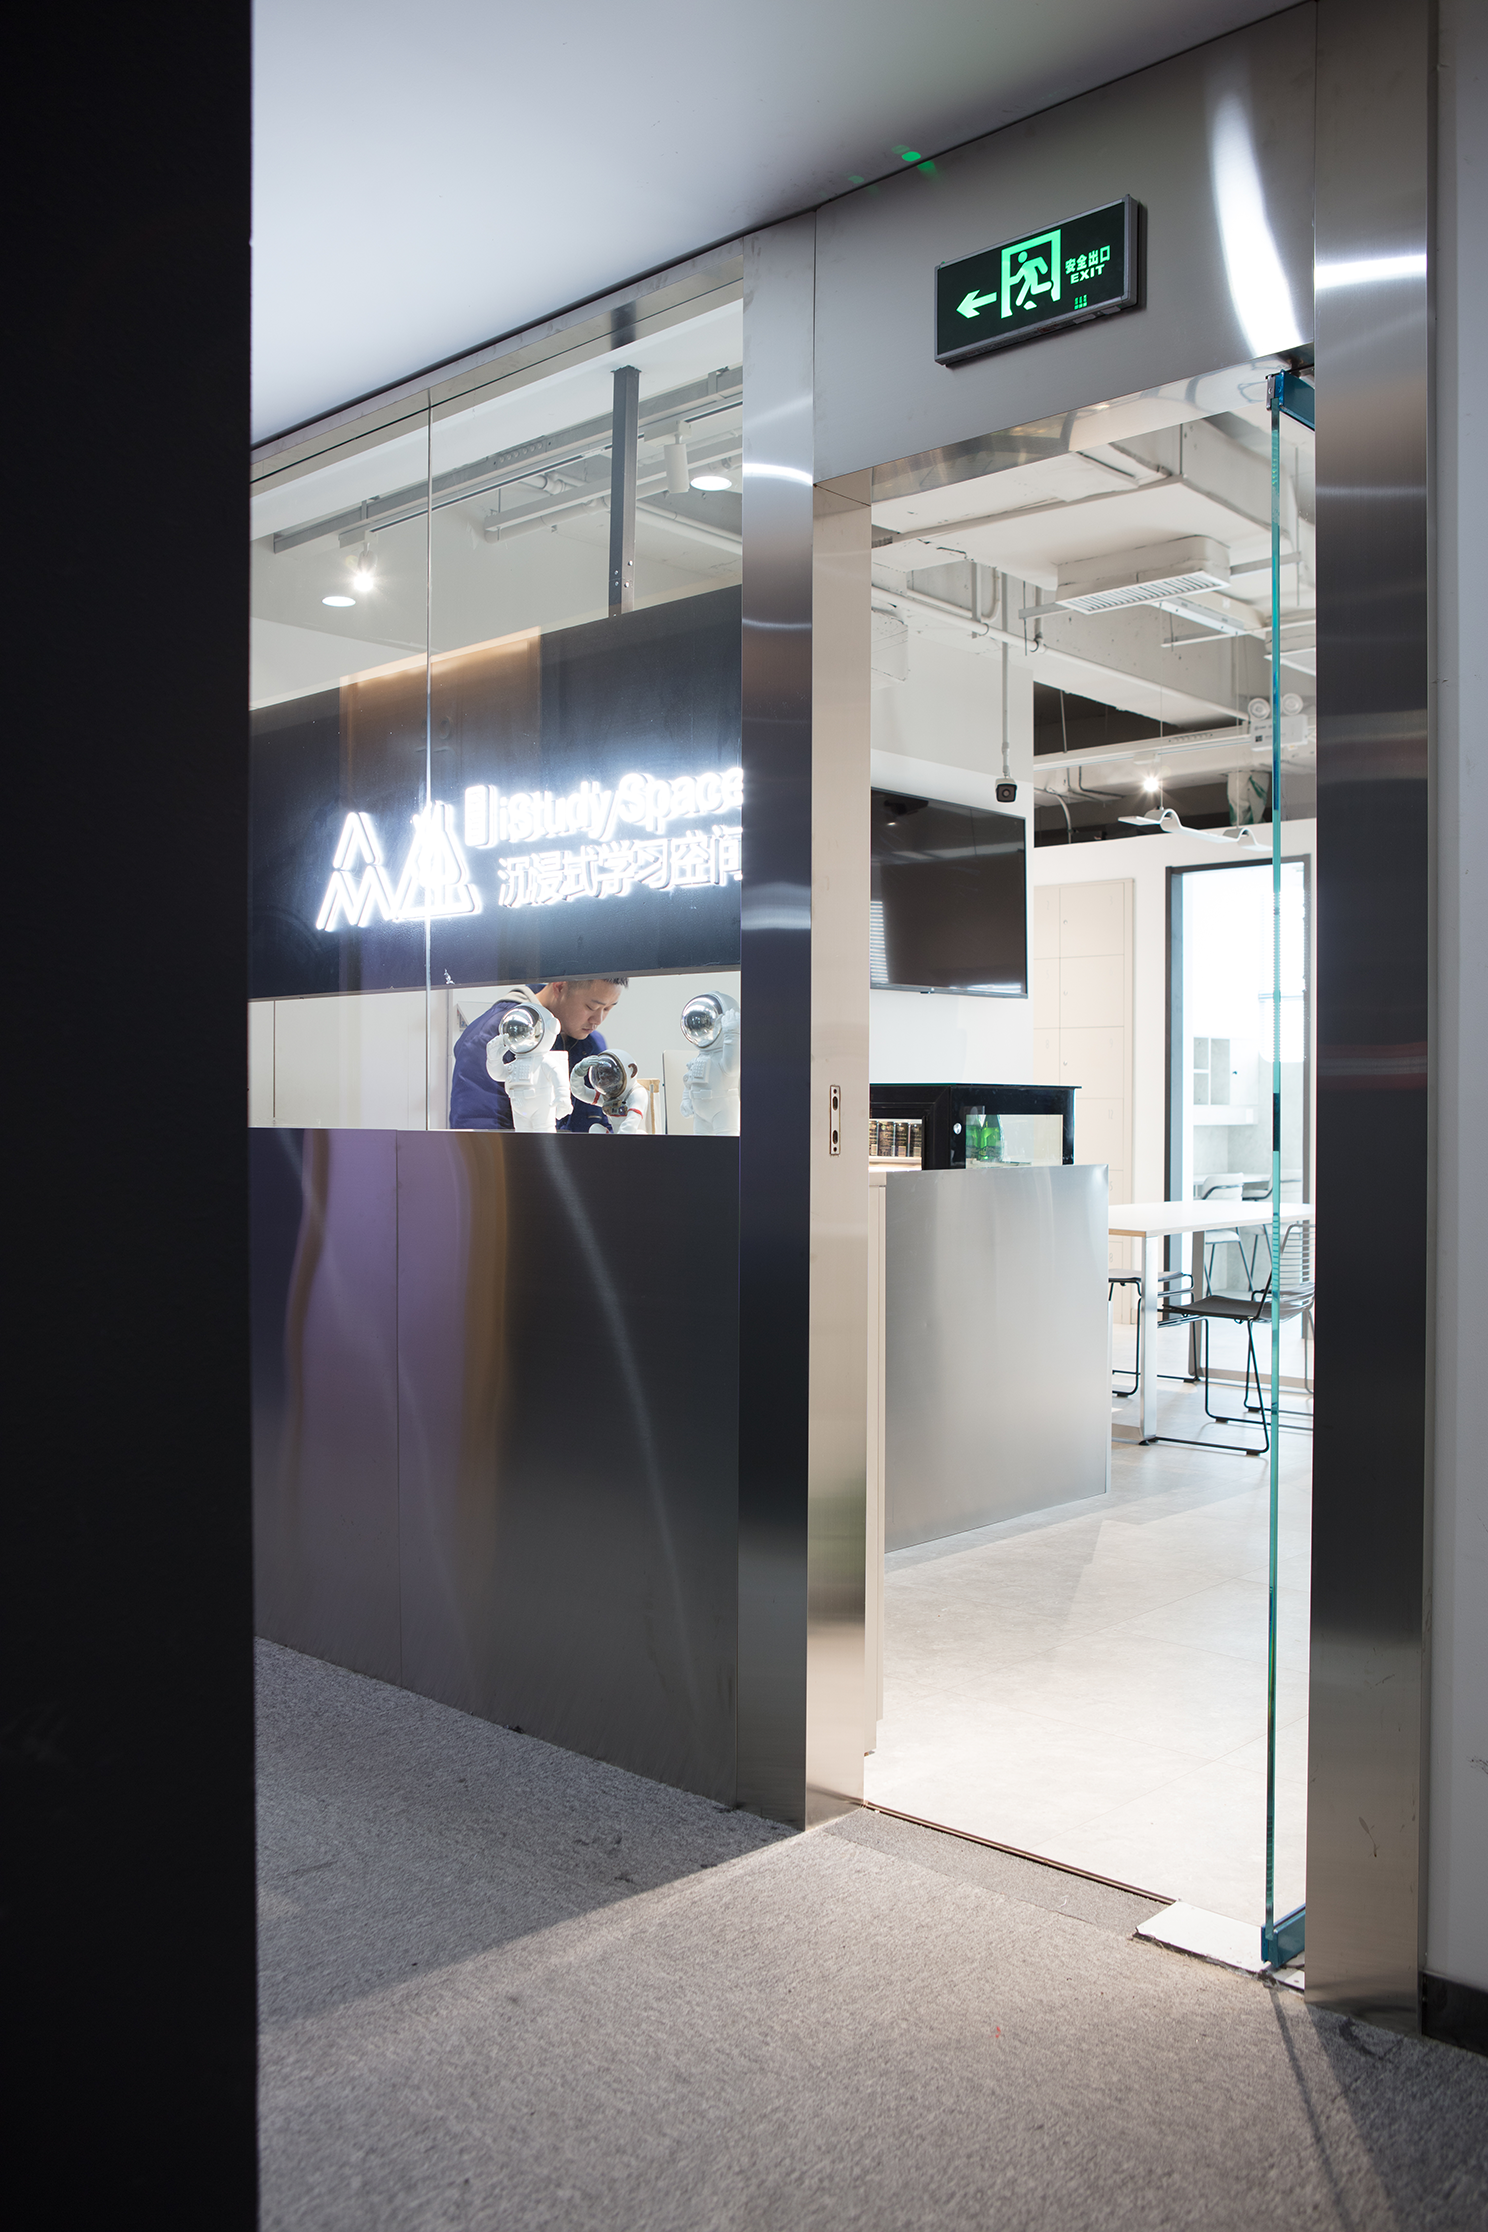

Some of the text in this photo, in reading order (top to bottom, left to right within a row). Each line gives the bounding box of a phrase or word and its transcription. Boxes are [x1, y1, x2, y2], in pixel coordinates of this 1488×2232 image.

[1065, 245, 1110, 275] 安全出口
[1070, 264, 1105, 284] EXIT
[1107, 1109, 1114, 1120] 12
